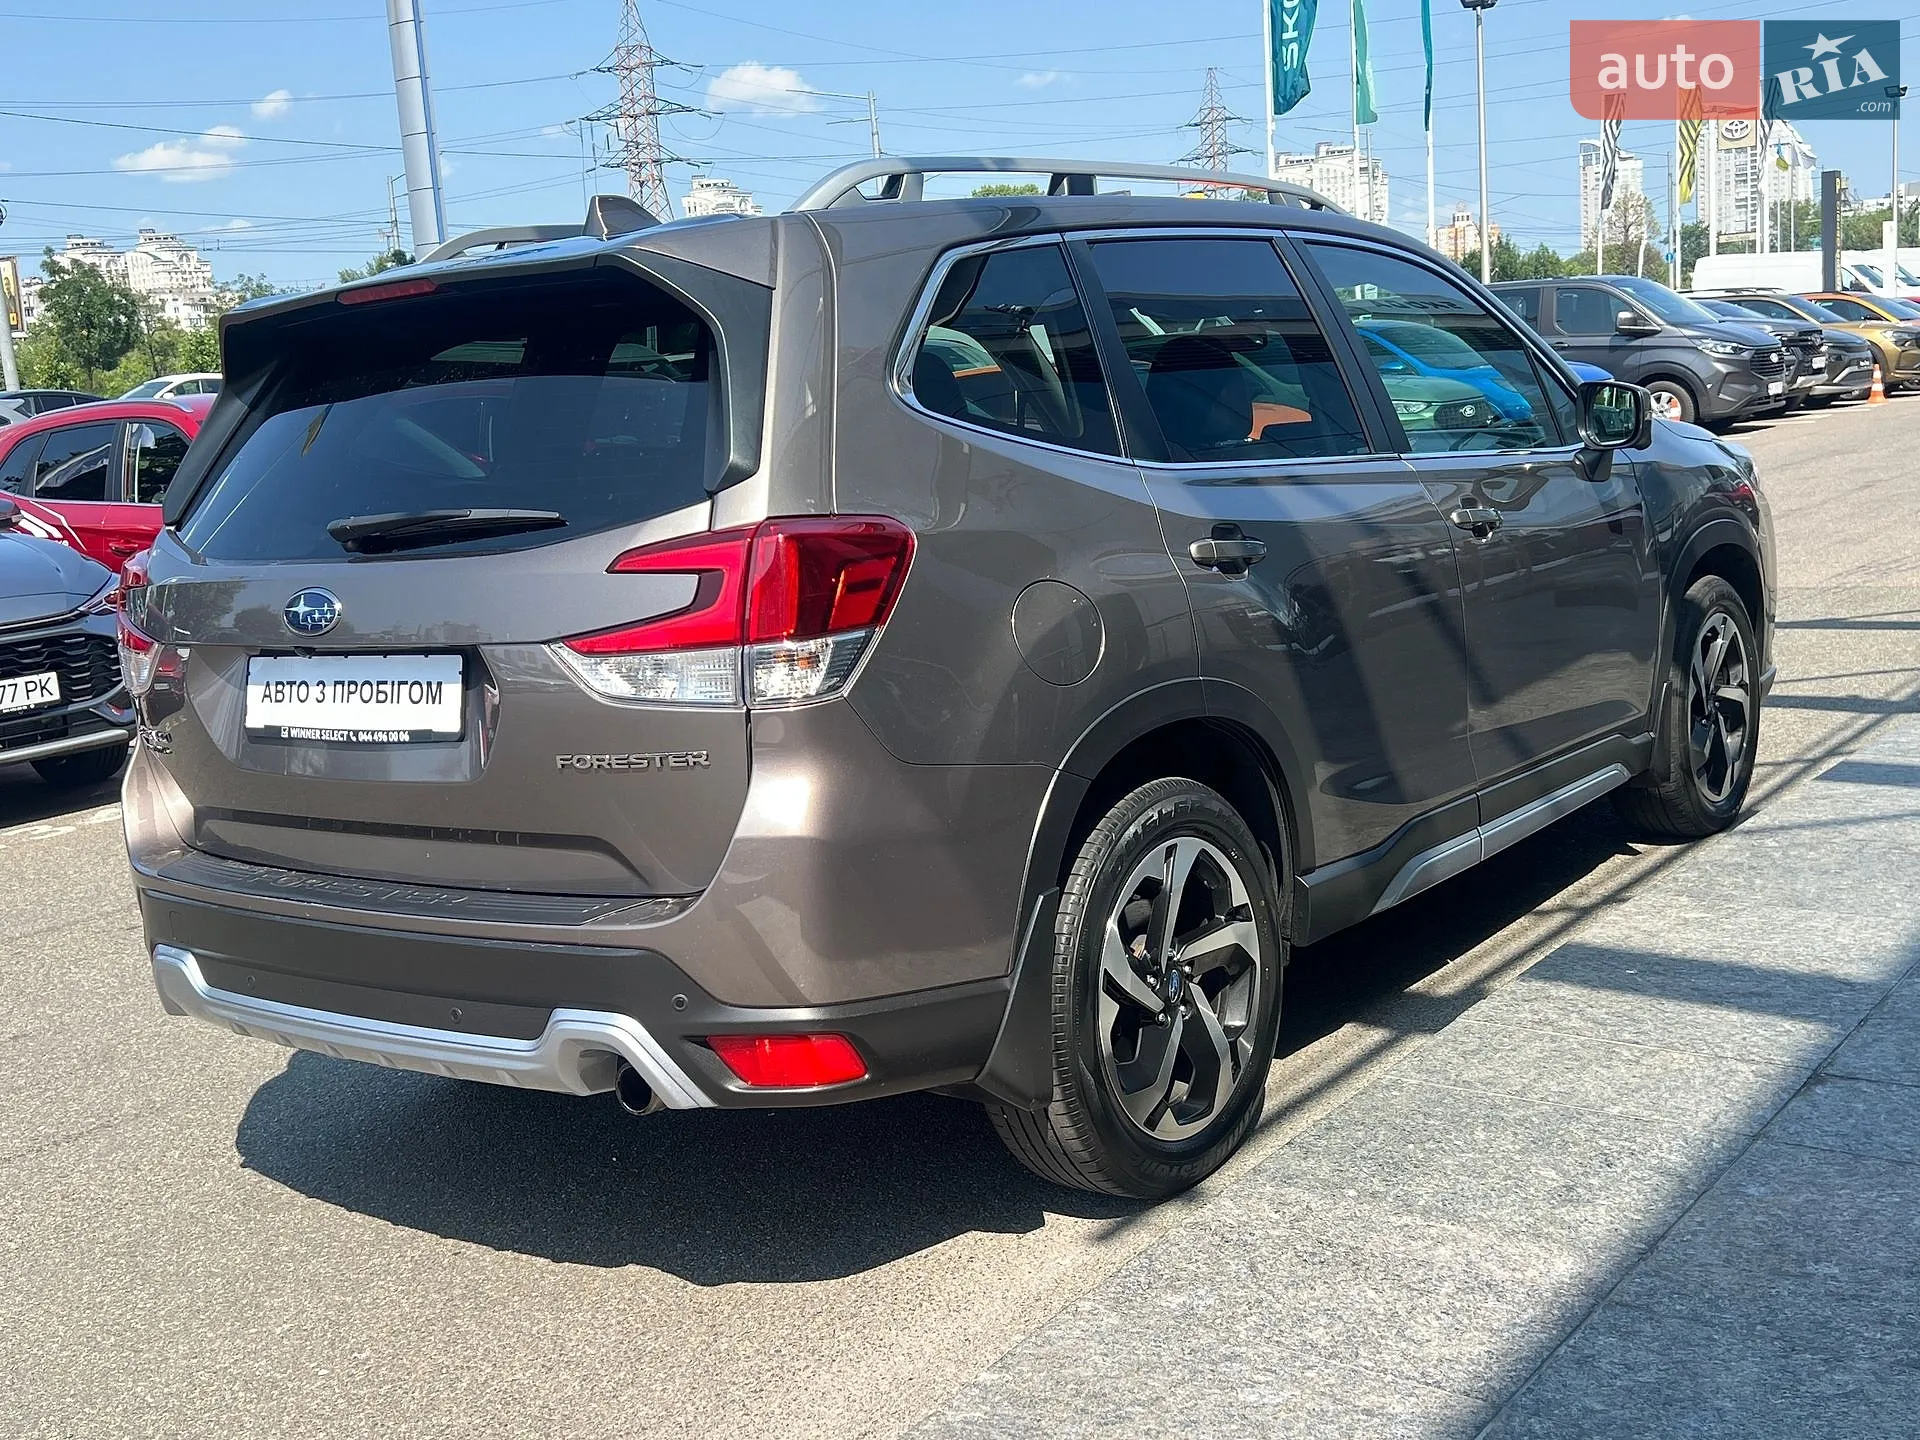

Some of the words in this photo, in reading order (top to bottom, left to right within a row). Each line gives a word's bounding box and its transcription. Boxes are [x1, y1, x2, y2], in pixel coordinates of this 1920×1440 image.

[1281, 0, 1299, 71] SK
[25, 677, 53, 700] PK
[261, 680, 310, 703] АВТО
[332, 680, 443, 705] ПРОБІГОМ
[290, 727, 320, 740] WINNER
[321, 730, 348, 741] SELECT
[555, 750, 710, 769] FORESTER
